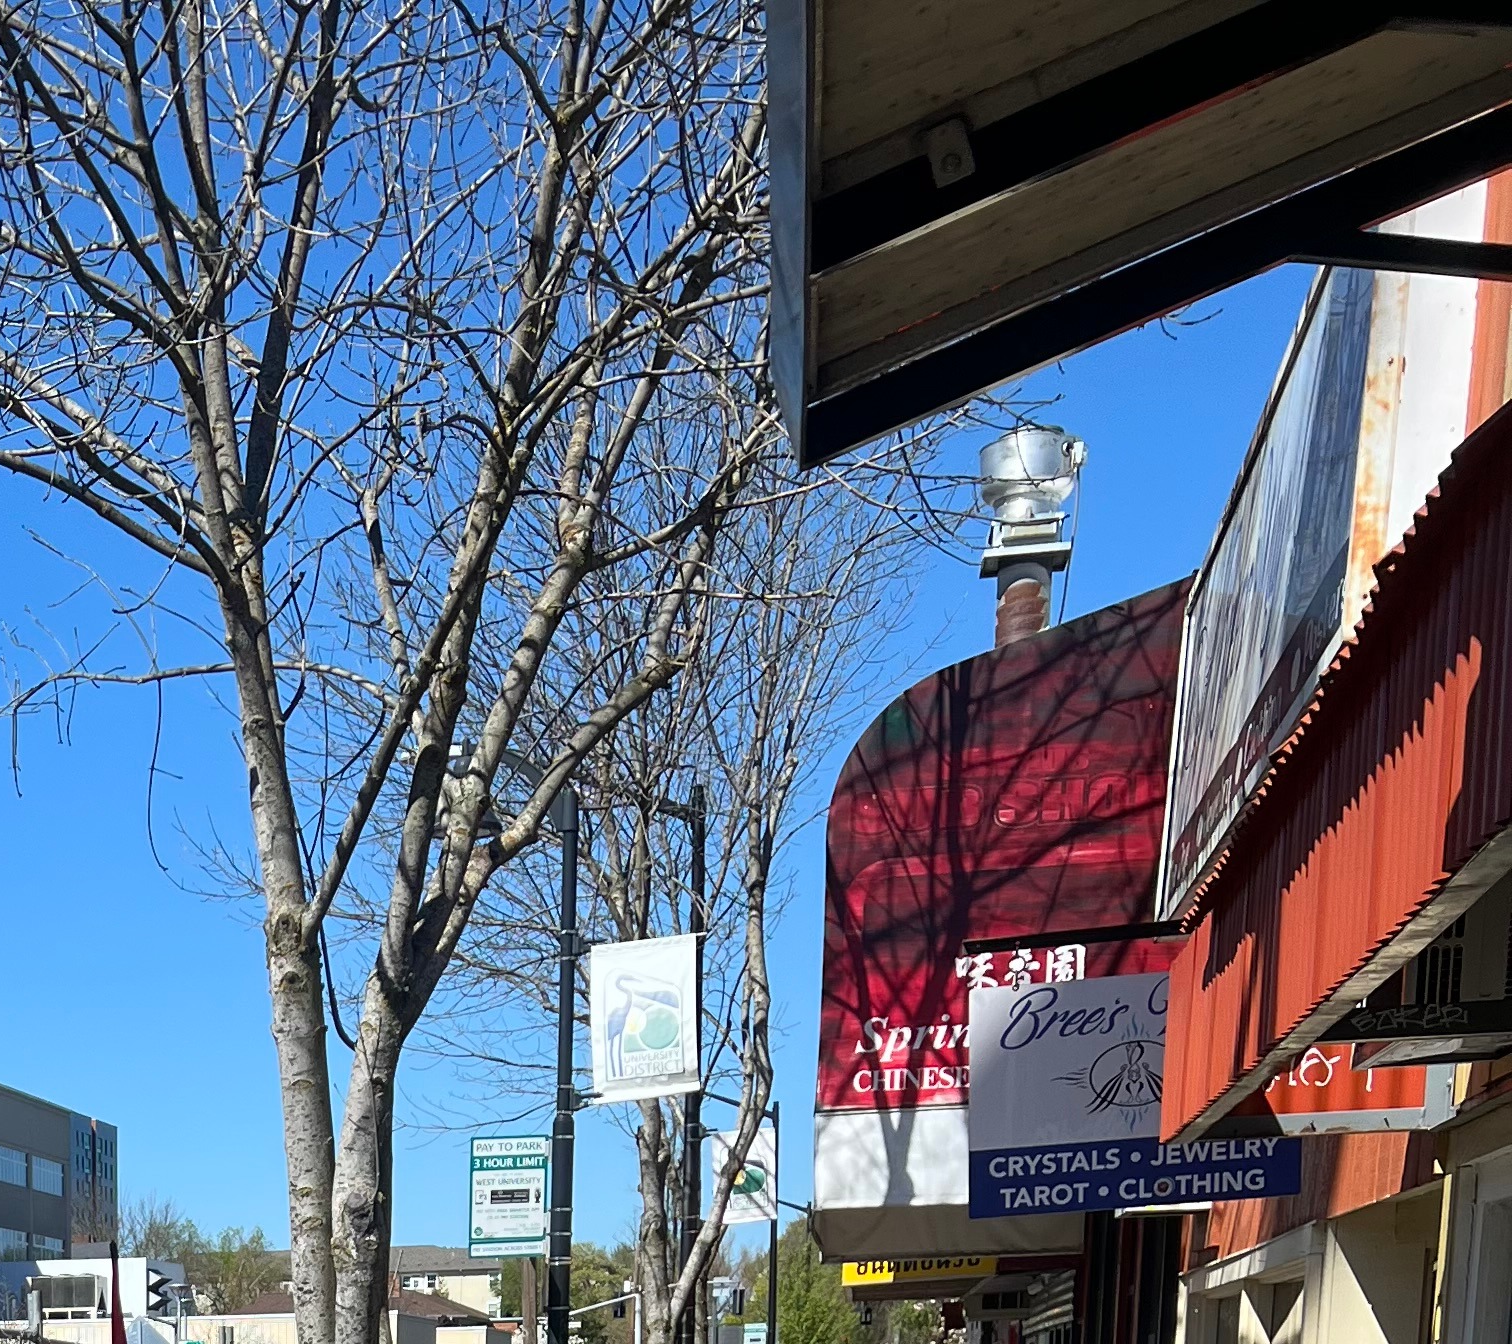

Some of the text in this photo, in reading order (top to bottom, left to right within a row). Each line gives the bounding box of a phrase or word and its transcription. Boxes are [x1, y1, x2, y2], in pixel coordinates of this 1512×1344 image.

[1000, 987, 1130, 1050] Bree's
[624, 1049, 680, 1063] UNIVERSITY
[624, 1059, 682, 1076] DISTRICT
[853, 1066, 970, 1093] CHINESE
[476, 1141, 543, 1152] PAY TO PARK
[473, 1156, 545, 1168] 3 HOUR LIMIT
[988, 1137, 1281, 1179] CRYSTALS JEWELRY
[475, 1176, 541, 1186] WEST UNIVERSITY
[1000, 1169, 1265, 1209] TAROT CLOTHING
